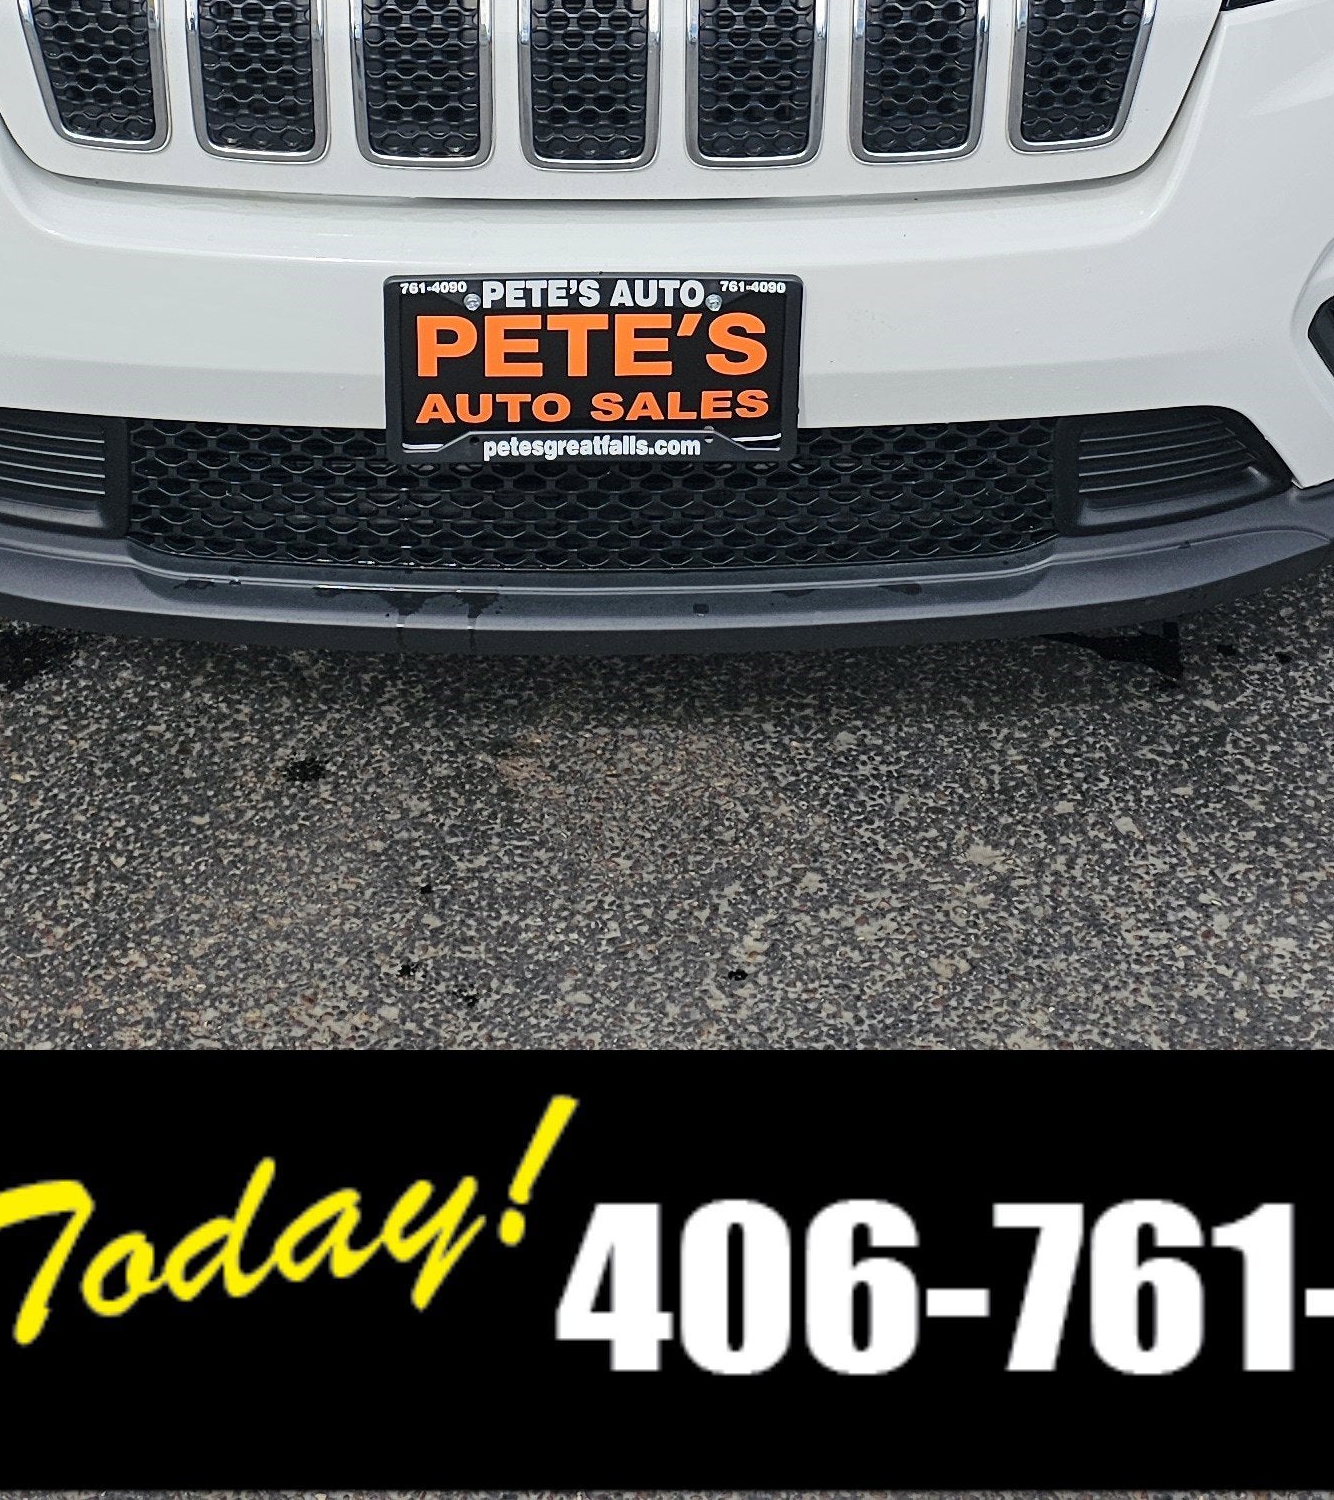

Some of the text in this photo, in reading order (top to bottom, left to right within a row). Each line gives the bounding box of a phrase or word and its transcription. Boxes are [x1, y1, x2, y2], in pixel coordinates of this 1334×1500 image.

[400, 280, 467, 295] 761-4090
[482, 279, 705, 310] PETE'S AUTO
[720, 280, 786, 295] 761-4090
[417, 312, 768, 377] PETE'S
[416, 389, 769, 424] AUTO SALES
[483, 434, 701, 462] petesgreatfalls.com
